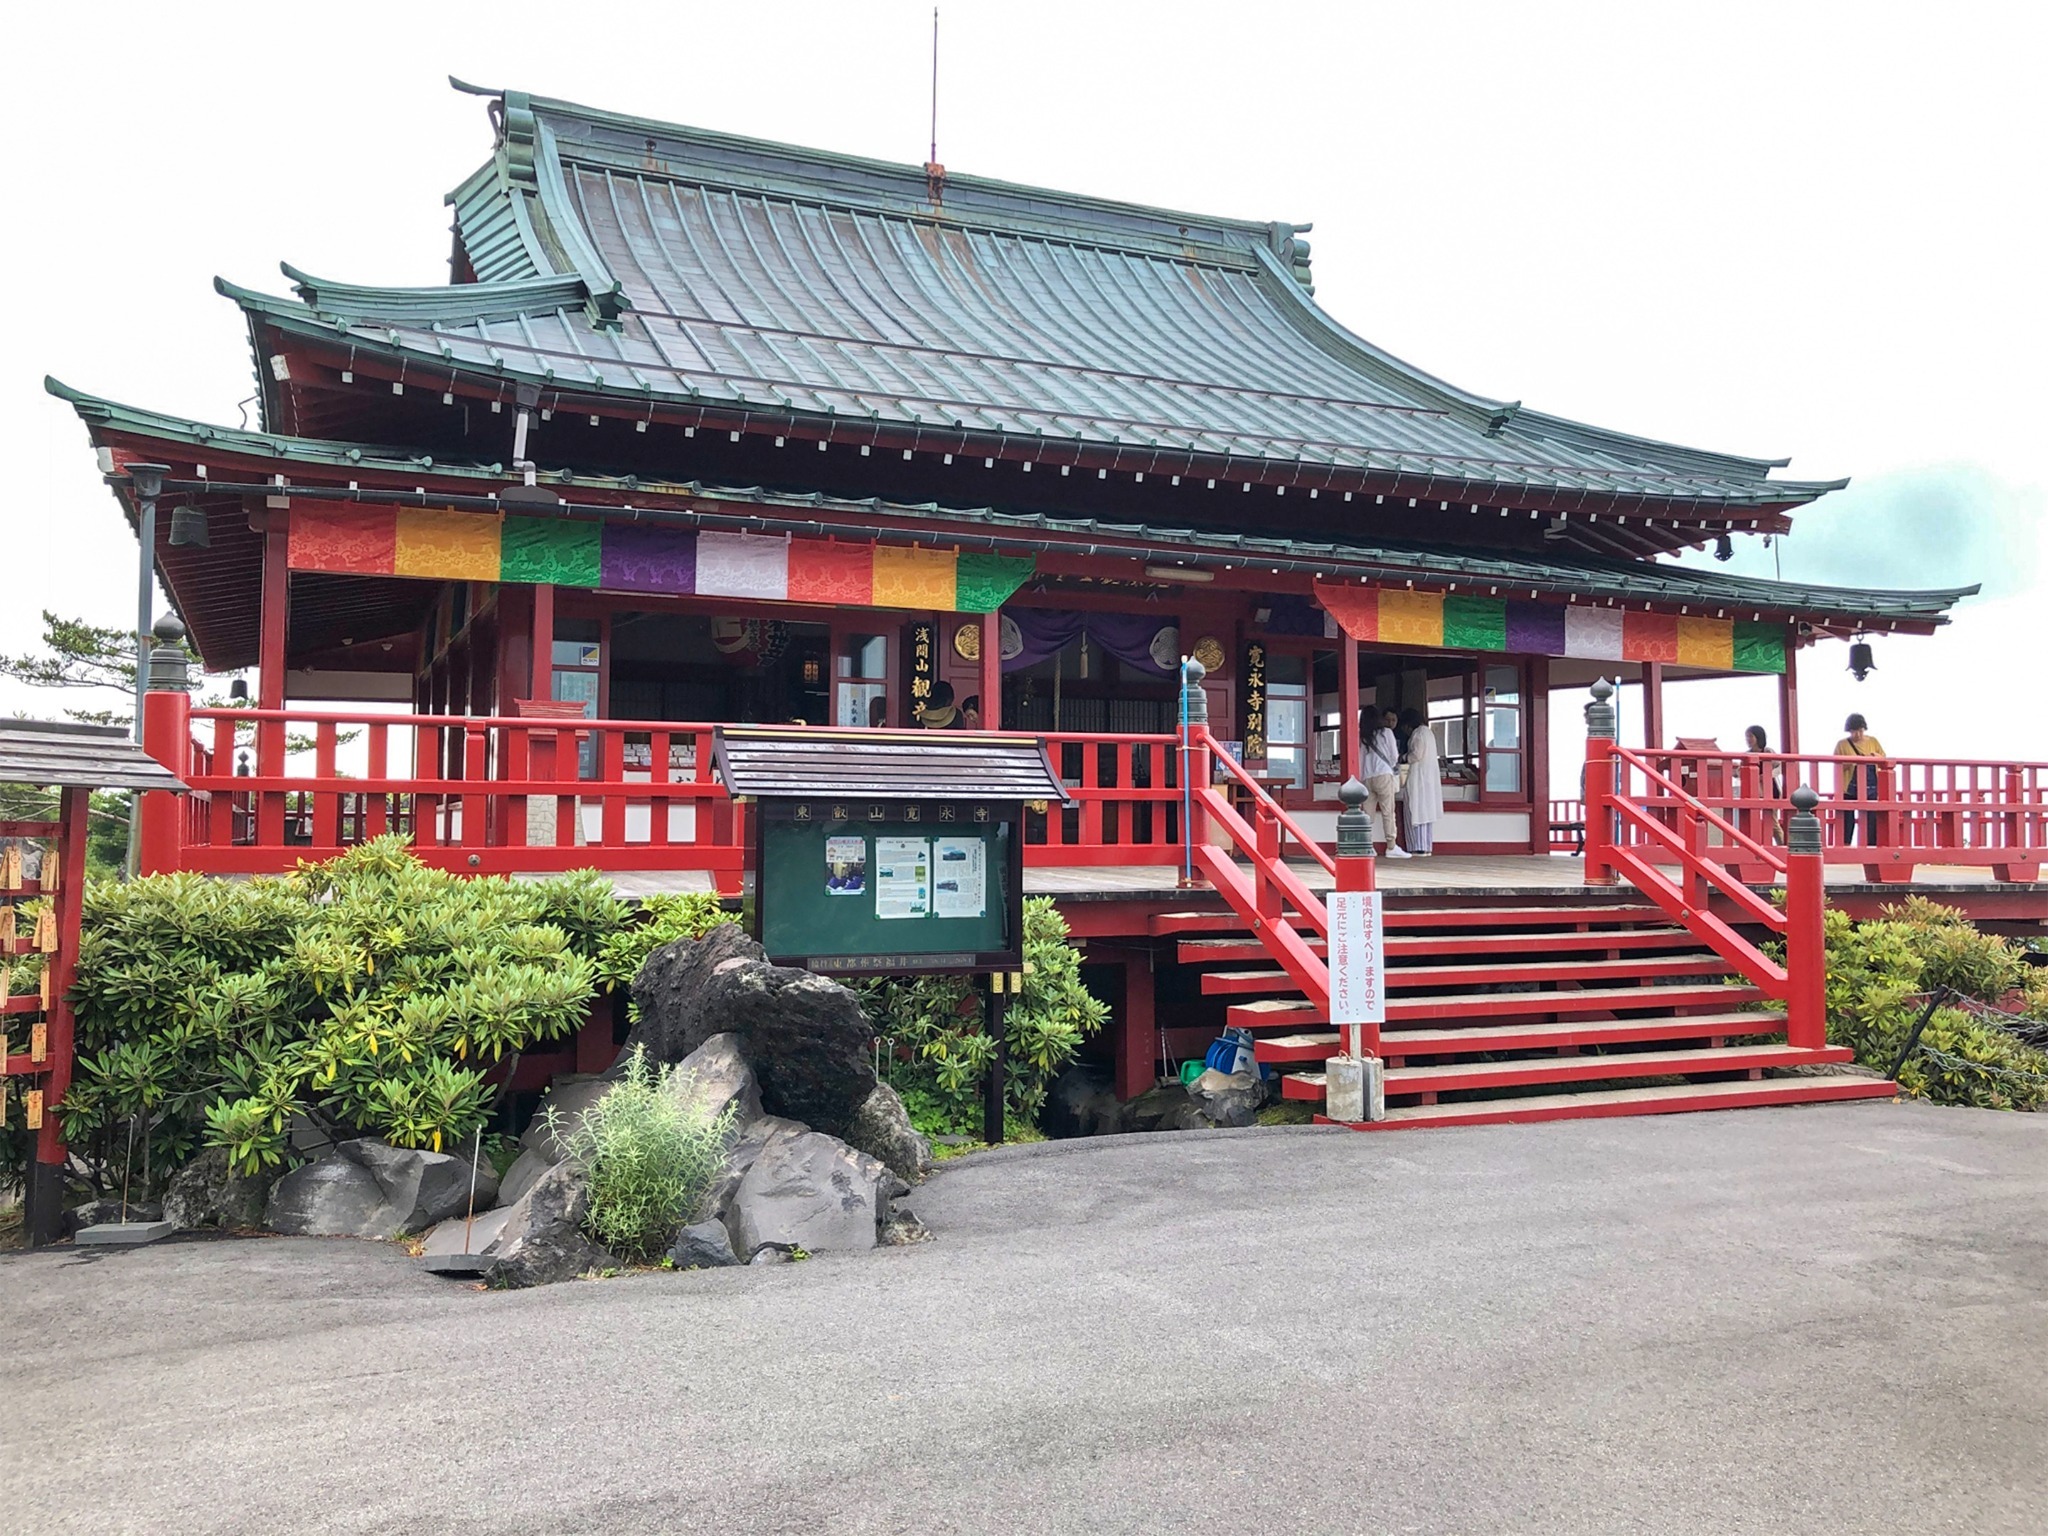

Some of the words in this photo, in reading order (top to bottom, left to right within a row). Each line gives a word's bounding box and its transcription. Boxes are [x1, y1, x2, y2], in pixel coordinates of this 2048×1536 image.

[1247, 645, 1264, 755] 寛永寺別院
[797, 806, 988, 821] 東叡山寛永寺
